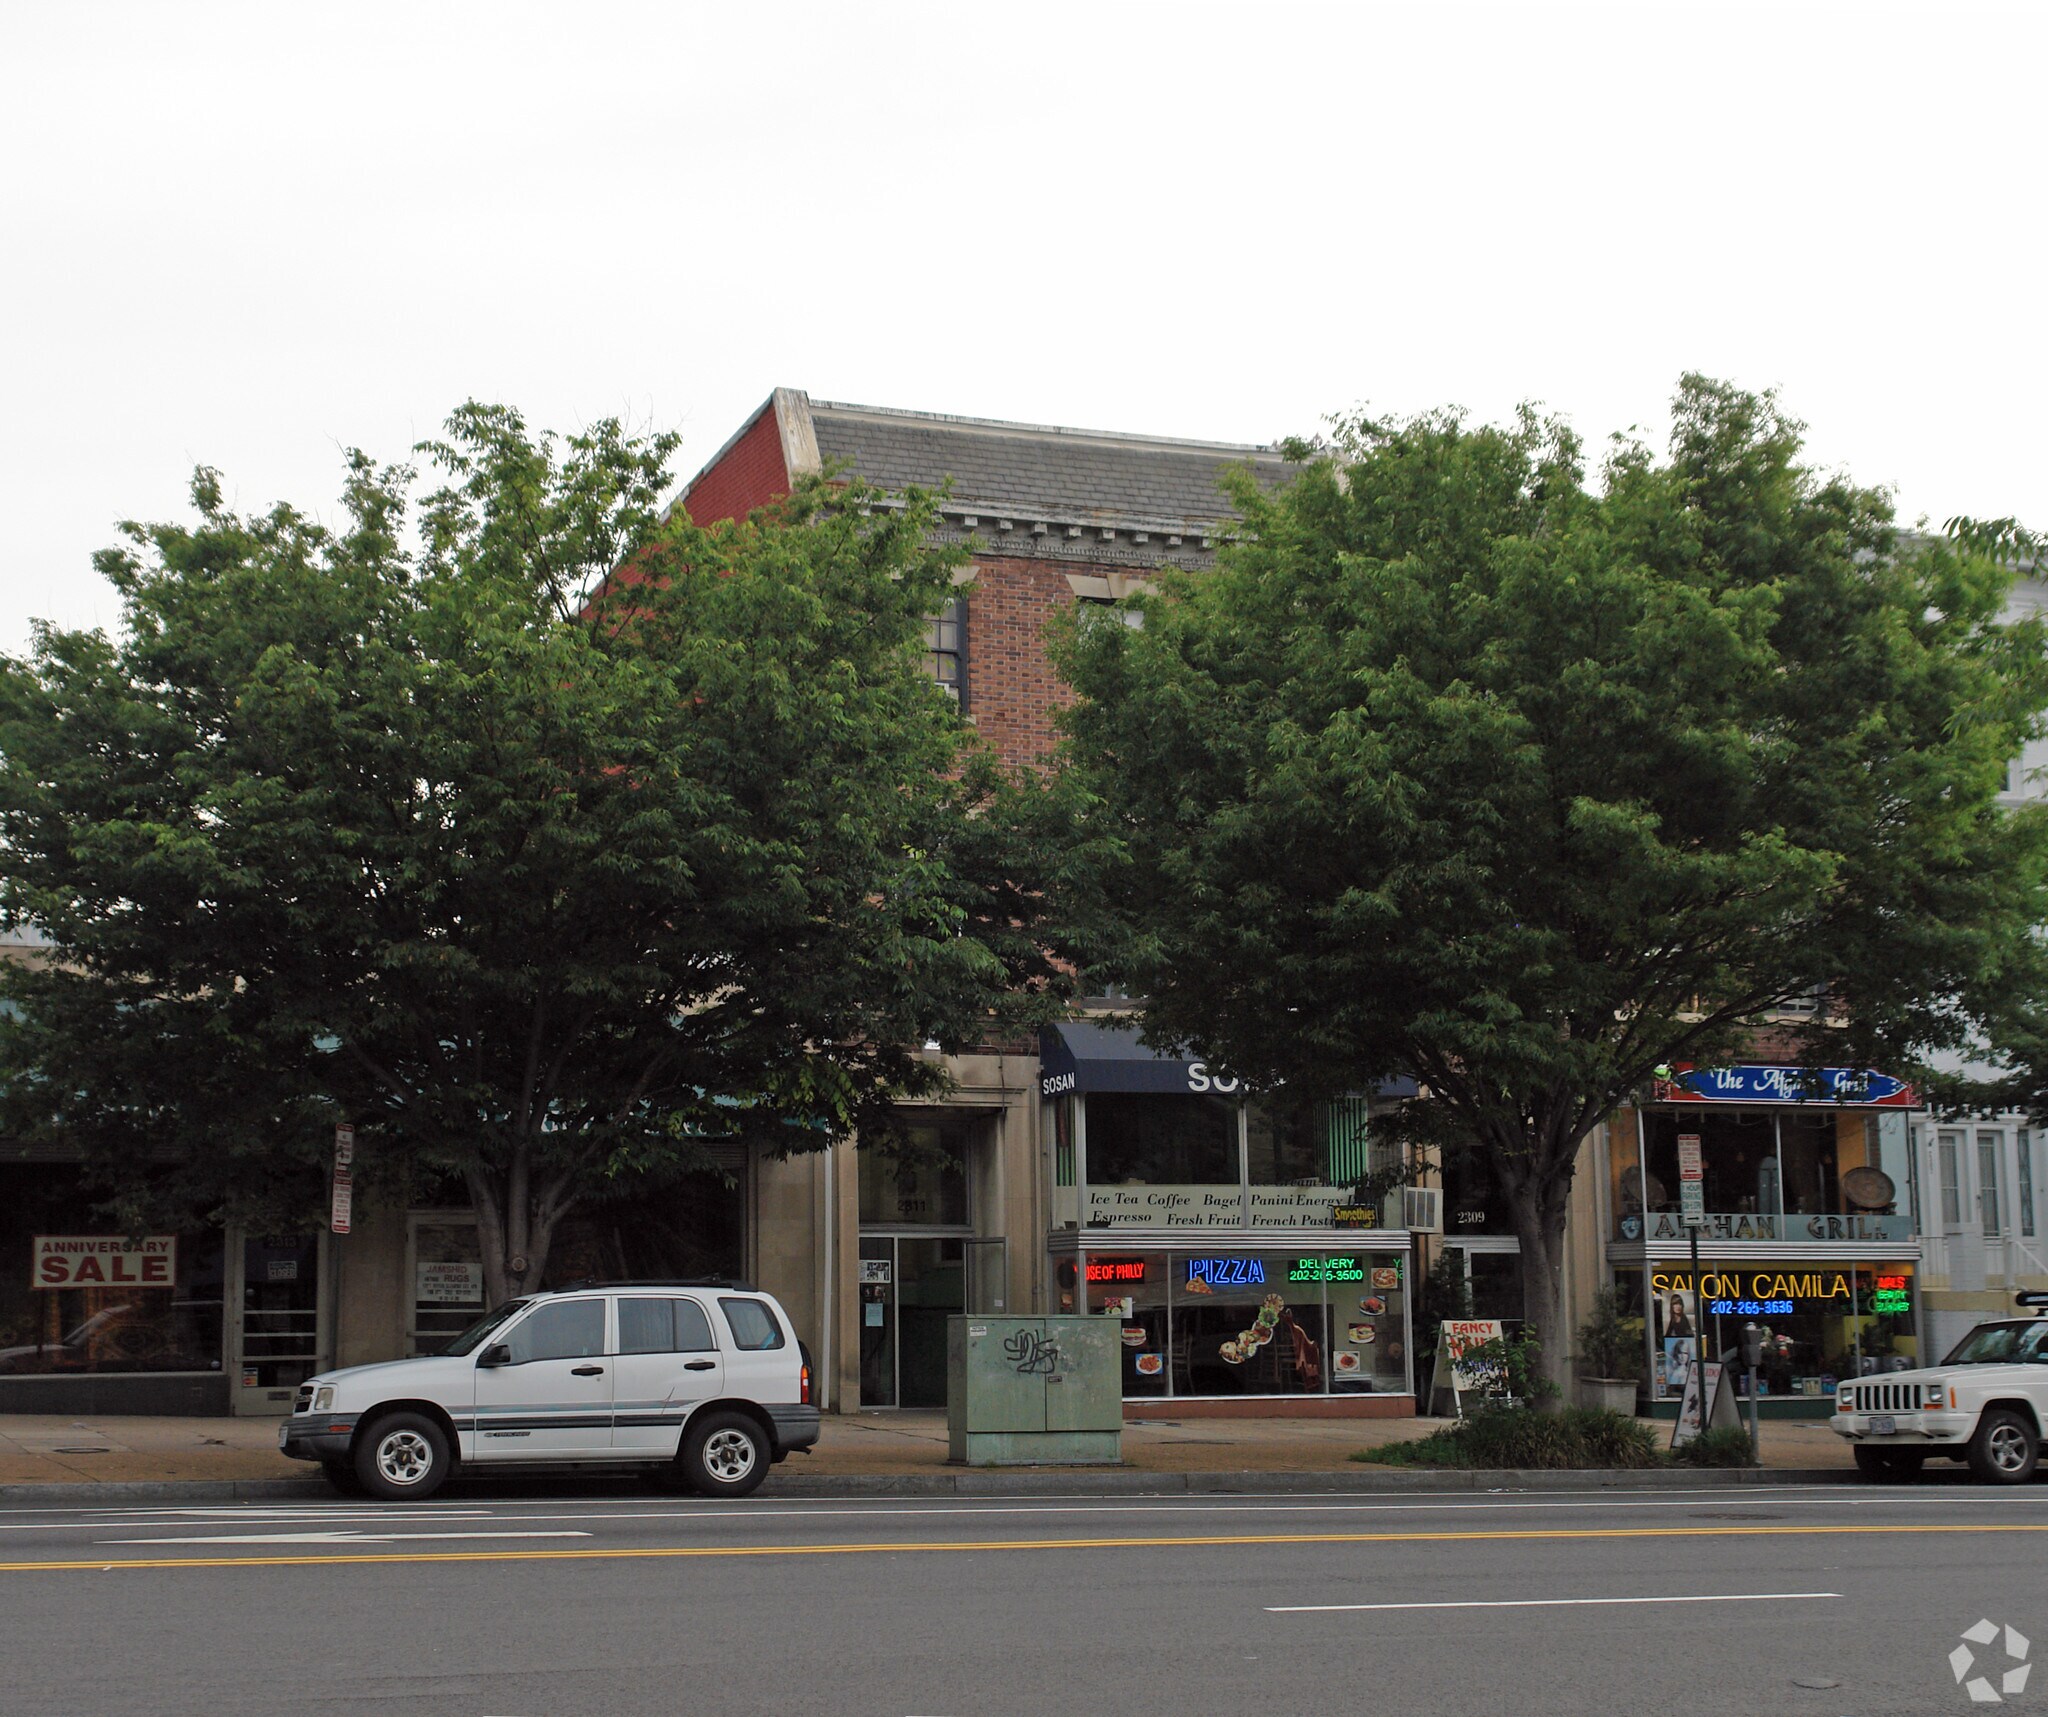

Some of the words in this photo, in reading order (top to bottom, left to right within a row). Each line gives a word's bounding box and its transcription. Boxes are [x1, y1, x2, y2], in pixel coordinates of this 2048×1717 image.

[1042, 1072, 1076, 1096] SOSAN
[1709, 1067, 1745, 1090] The
[1090, 1192, 1110, 1205] Ice
[1115, 1192, 1139, 1205] Tea
[1147, 1193, 1191, 1209] Coffee
[1203, 1194, 1241, 1209] Bagel
[1250, 1194, 1293, 1206] Panini
[1092, 1210, 1153, 1224] Espresso
[1167, 1213, 1203, 1226] Fresh
[1208, 1213, 1241, 1226] Fruit
[1252, 1214, 1296, 1226] French
[1333, 1207, 1376, 1222] Smoothies
[1457, 1211, 1486, 1224] 2309
[41, 1241, 169, 1253] ANNIVERSARY
[40, 1255, 169, 1283] SALE
[426, 1264, 468, 1274] JAMSHID
[1102, 1264, 1115, 1280] OF
[1116, 1263, 1145, 1280] PHILLY
[1189, 1258, 1266, 1284] PIZZA
[1299, 1258, 1355, 1270] DELVERY
[443, 1274, 470, 1283] RUGS
[1751, 1273, 1851, 1299] CAMILA
[1710, 1300, 1794, 1315] 202-265-3636
[1451, 1322, 1494, 1334] FANCY
